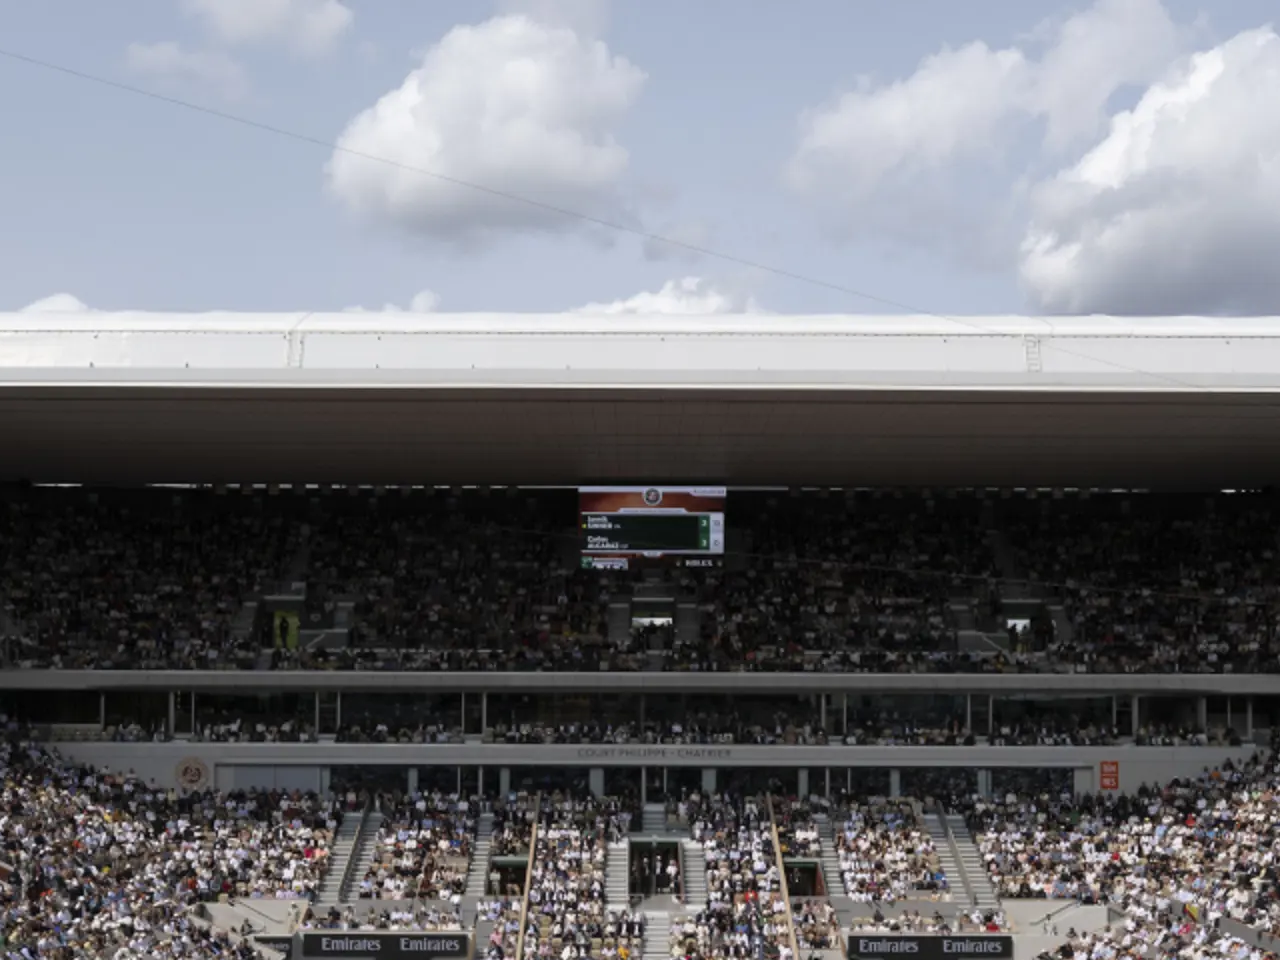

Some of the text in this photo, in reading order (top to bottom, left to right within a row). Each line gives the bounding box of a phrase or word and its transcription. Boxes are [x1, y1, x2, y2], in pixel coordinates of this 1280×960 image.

[321, 937, 460, 951] Emirates Emirates
[859, 939, 1003, 953] Emirates Emirates
